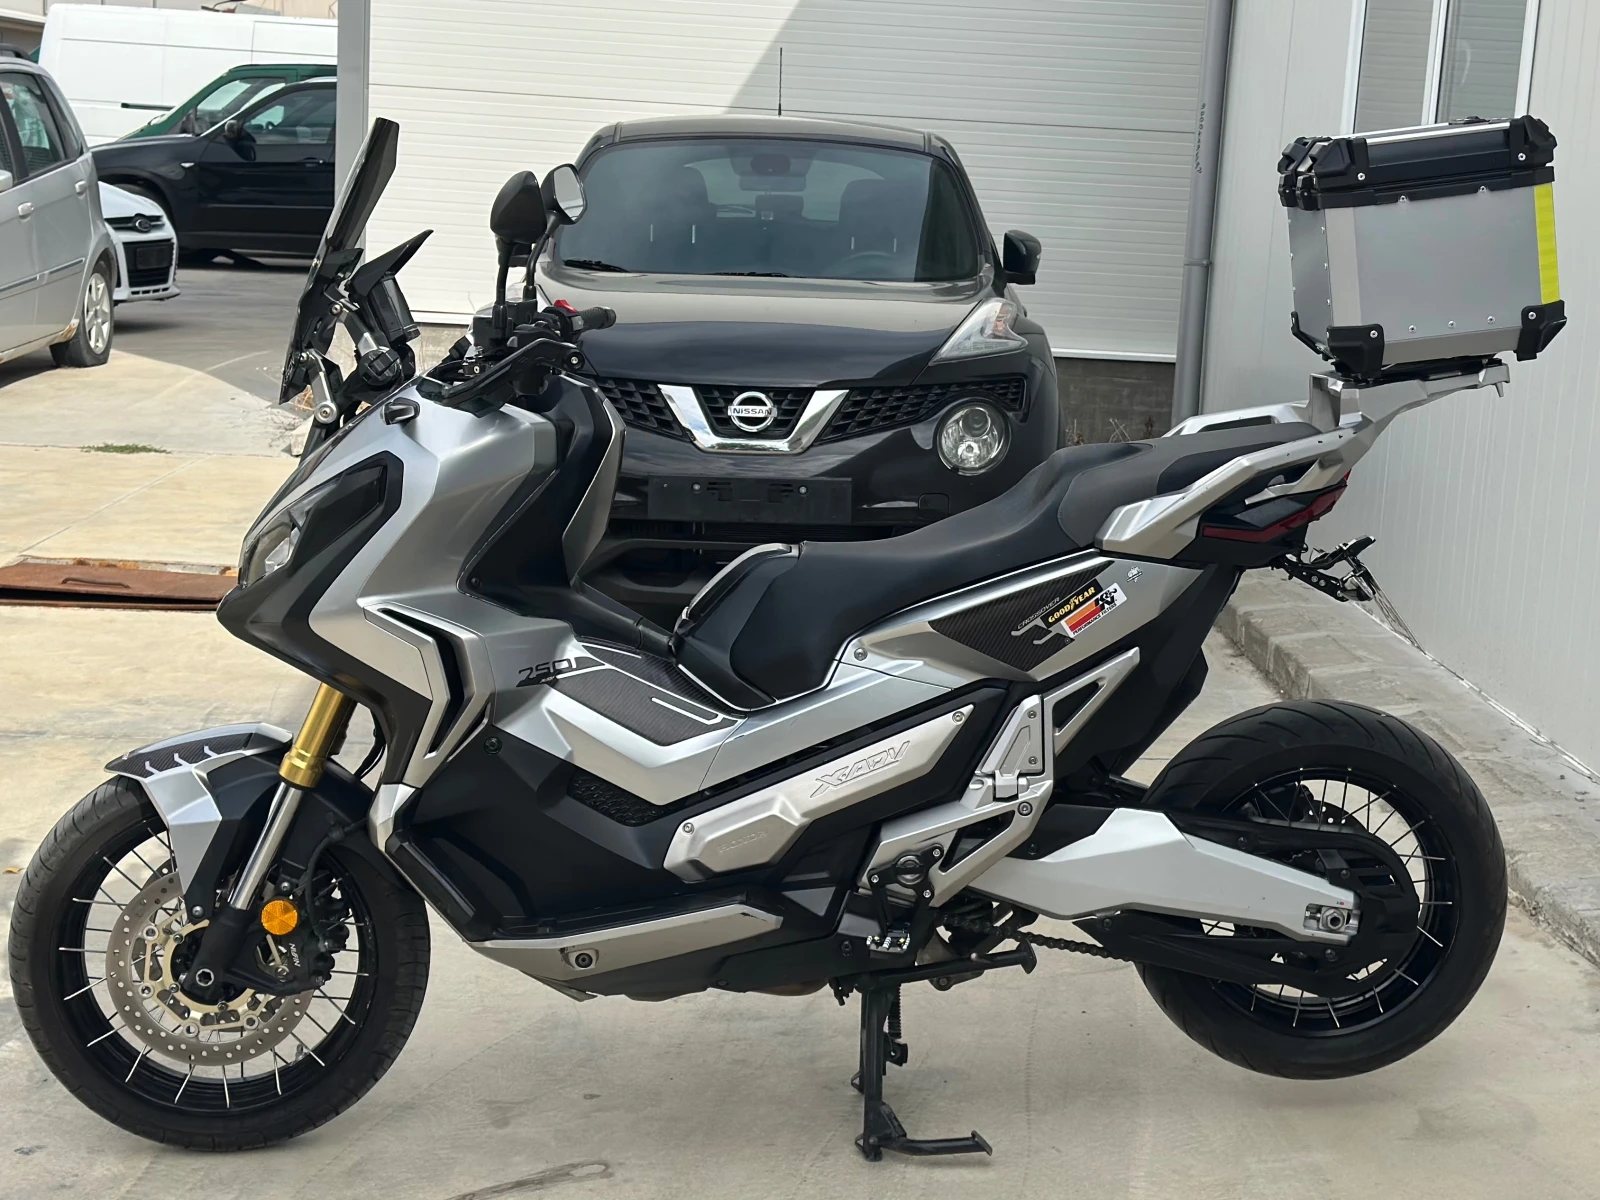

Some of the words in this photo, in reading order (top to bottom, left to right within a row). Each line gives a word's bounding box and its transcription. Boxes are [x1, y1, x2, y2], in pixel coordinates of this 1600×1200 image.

[732, 407, 773, 416] NISSAN
[1017, 597, 1060, 629] CROSSOVER
[1048, 586, 1096, 623] GOODYEAR
